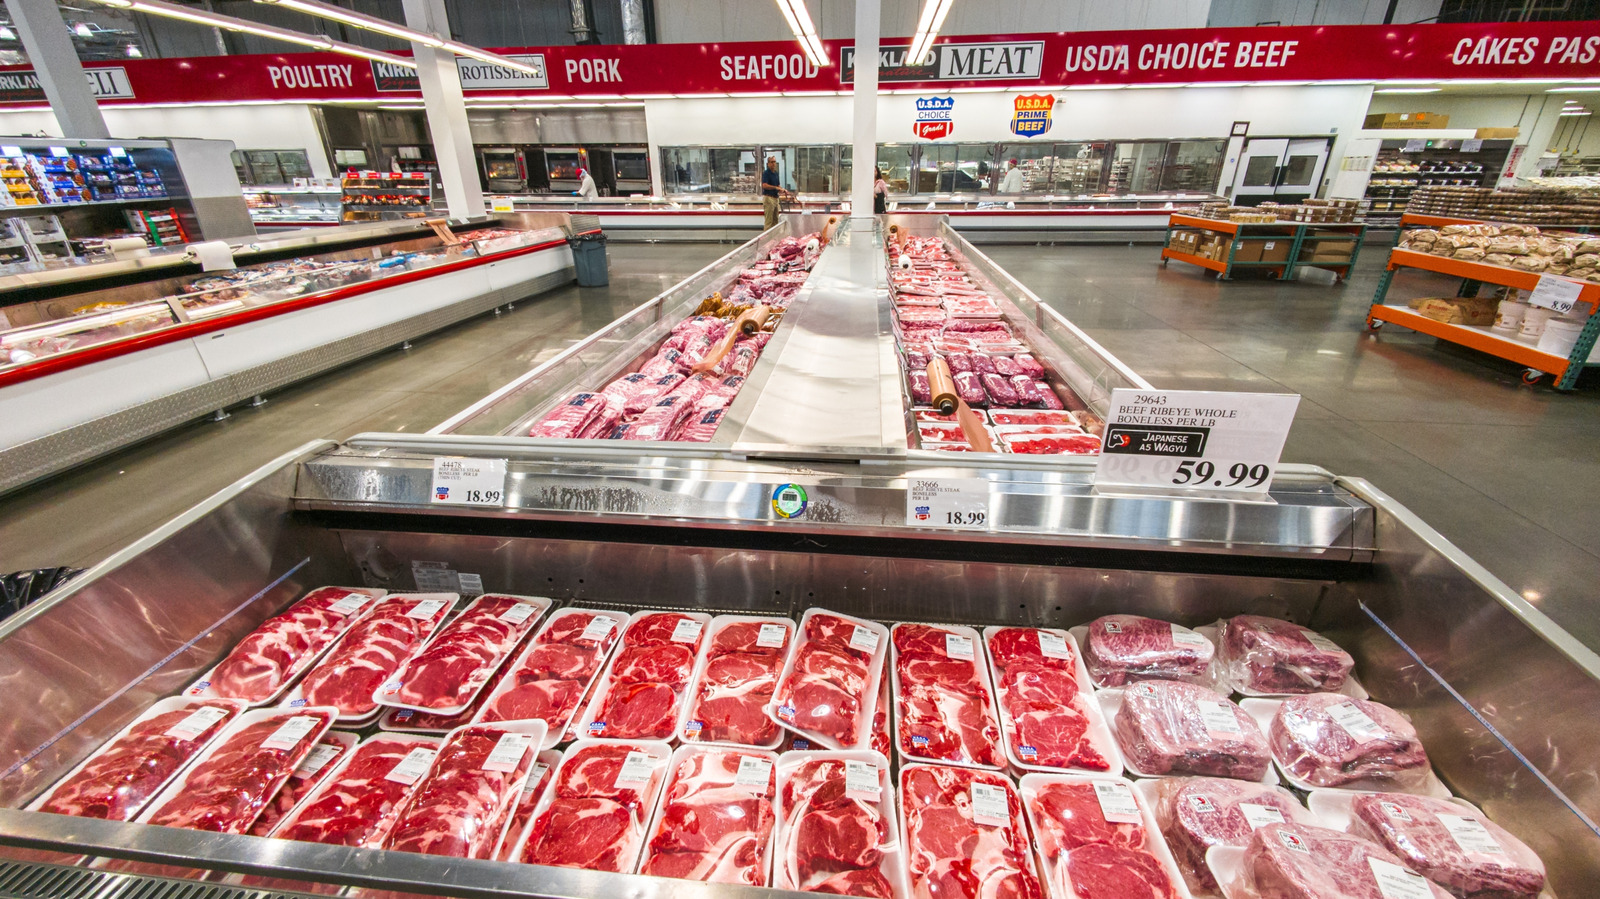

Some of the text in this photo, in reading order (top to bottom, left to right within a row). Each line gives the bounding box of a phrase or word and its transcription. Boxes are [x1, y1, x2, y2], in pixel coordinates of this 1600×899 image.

[1065, 40, 1299, 72] USDA CHOICE BEEF
[1452, 36, 1600, 65] CAKES PAS
[721, 53, 819, 80] SEAFOOD
[948, 46, 1035, 76] MEAT
[269, 64, 353, 89] POULTRY
[377, 62, 418, 77] KIRK
[565, 58, 623, 83] PORK
[0, 75, 43, 89] RKLAN
[85, 71, 120, 95] ELI
[918, 111, 950, 119] CHOICE
[1017, 110, 1048, 119] PRIME
[922, 123, 945, 136] Grade
[1018, 121, 1044, 131] BEEF
[1551, 300, 1572, 313] 8.99
[1134, 395, 1167, 405] 29643
[1119, 405, 1238, 419] BEEF RIBEYE WHOLE
[1117, 415, 1216, 427] BONELESS PER LB
[1172, 460, 1270, 488] 59.99
[466, 490, 500, 503] 18.99
[946, 511, 986, 526] 18.99
